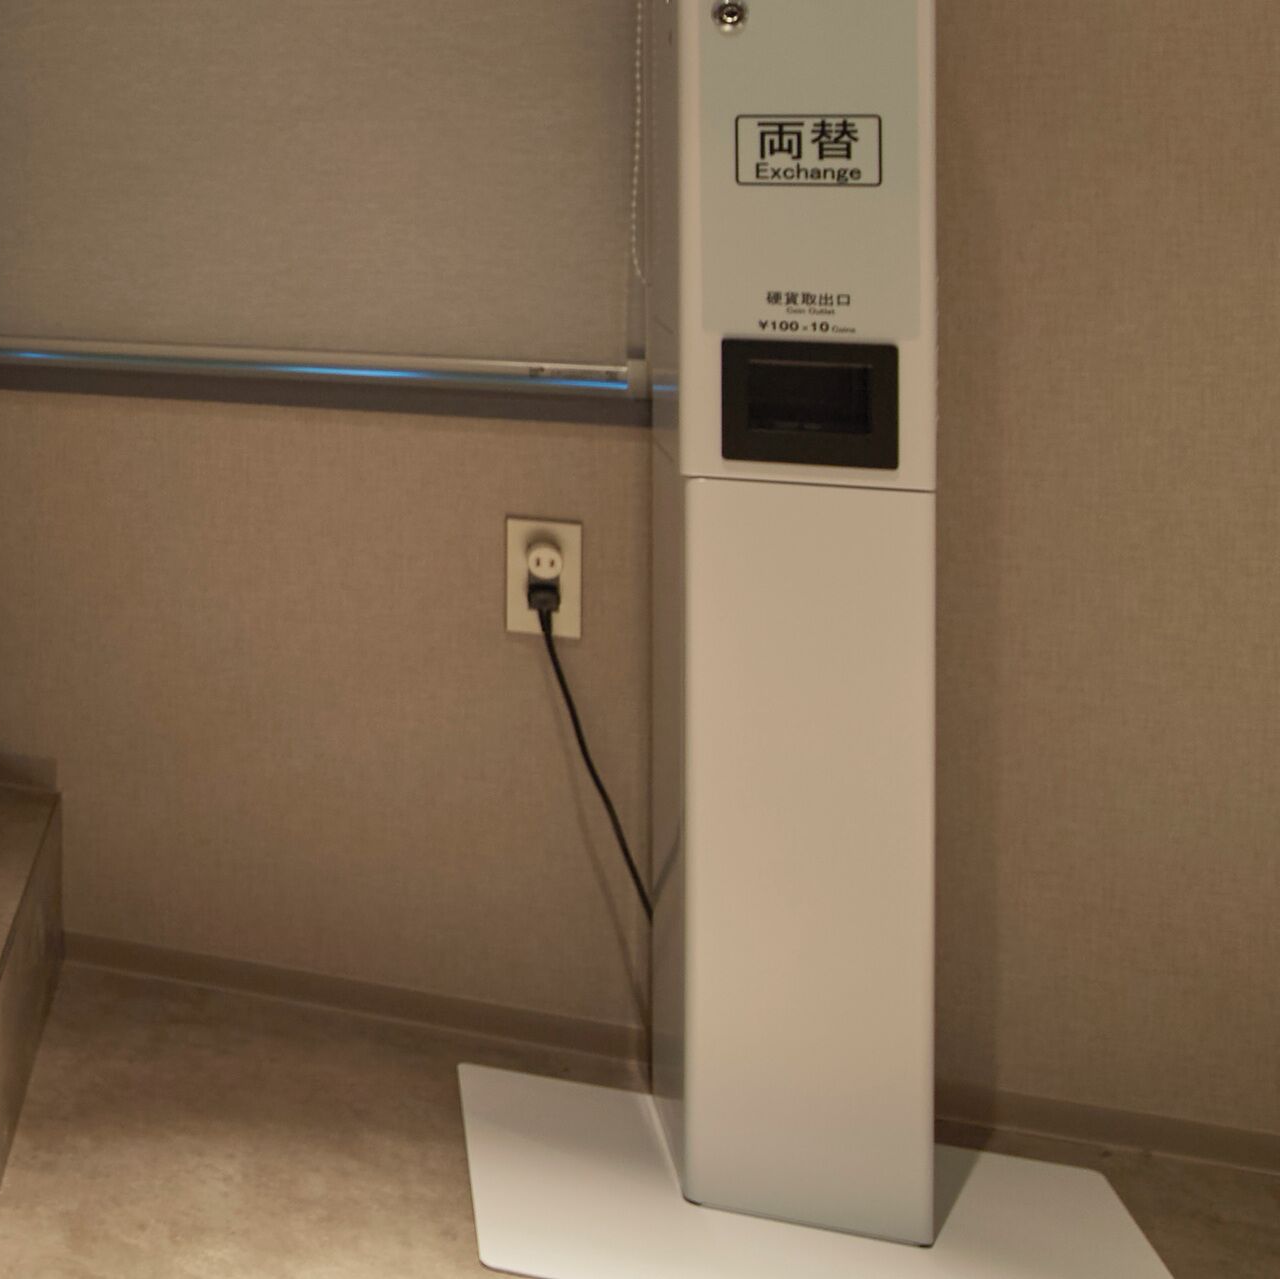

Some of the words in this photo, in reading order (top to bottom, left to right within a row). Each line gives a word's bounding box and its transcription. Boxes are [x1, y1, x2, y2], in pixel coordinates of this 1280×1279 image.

[757, 119, 860, 161] 両替
[755, 161, 862, 183] Exchange
[766, 290, 851, 307] 硬貨取出口
